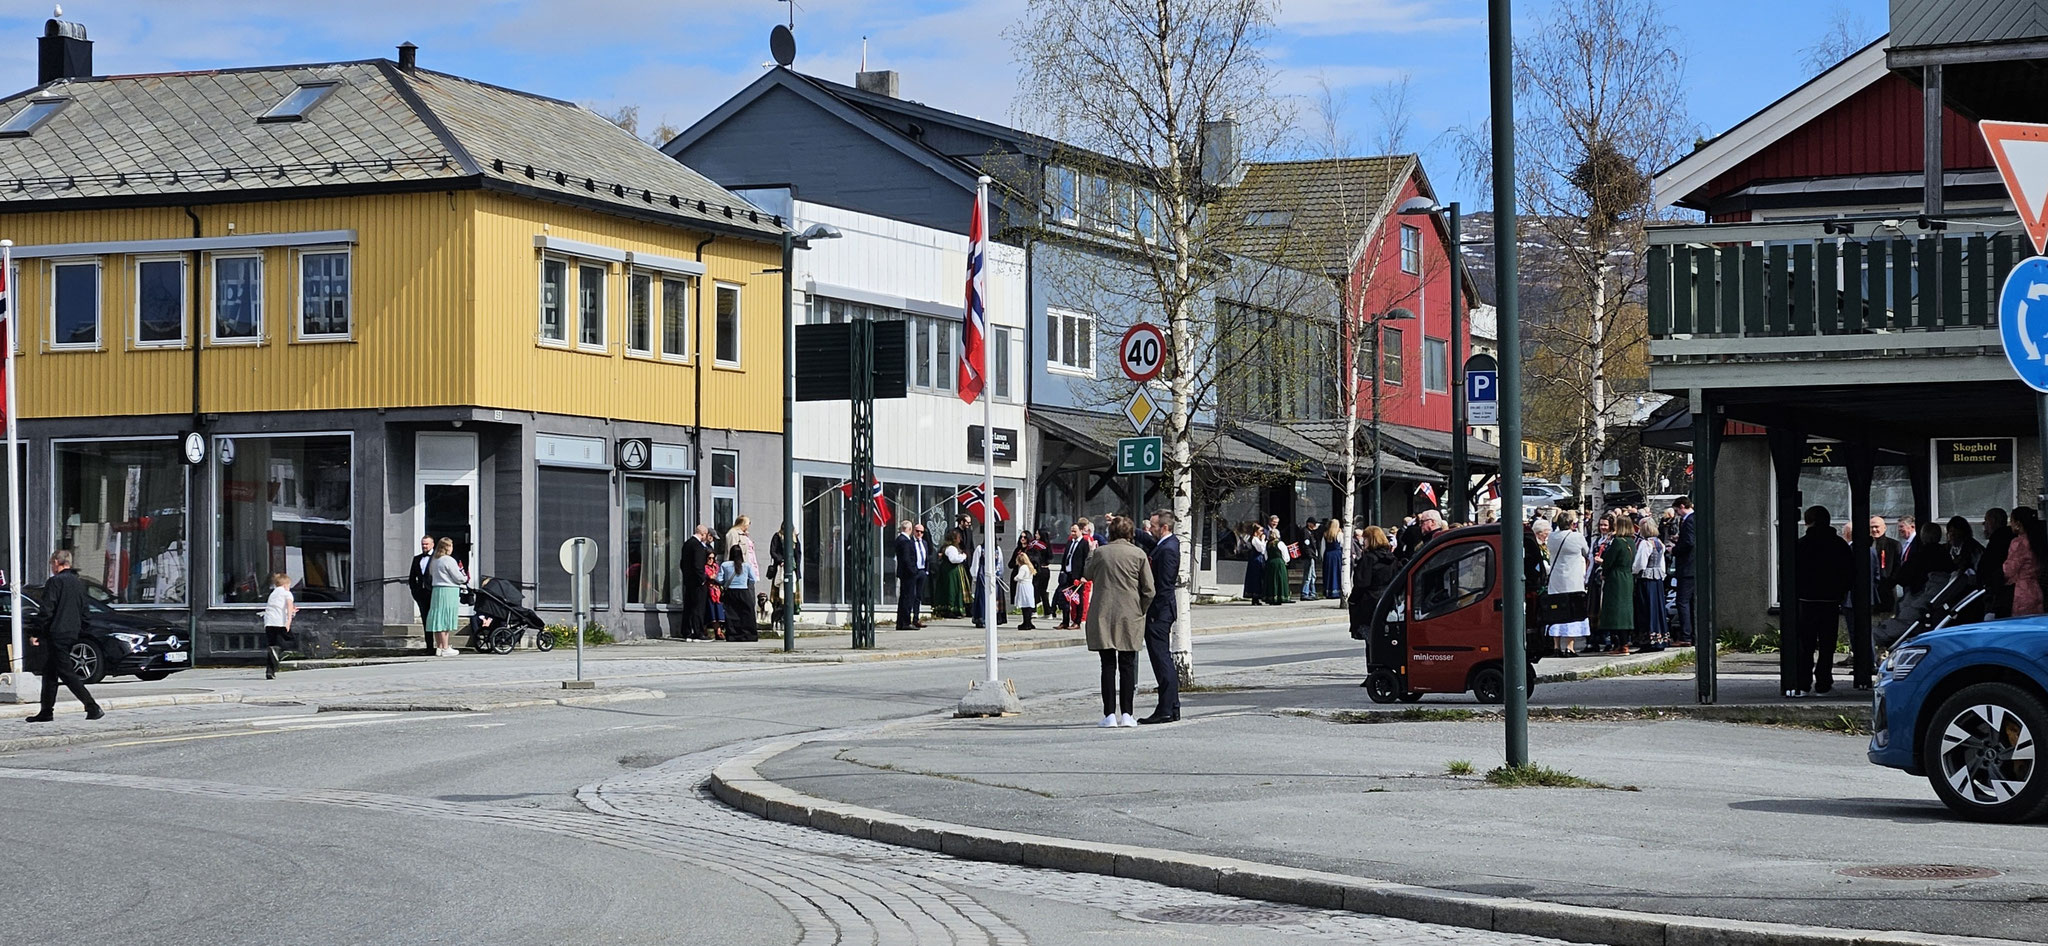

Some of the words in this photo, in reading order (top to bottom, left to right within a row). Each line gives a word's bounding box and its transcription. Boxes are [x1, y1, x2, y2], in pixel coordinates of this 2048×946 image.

[1127, 338, 1158, 367] 40
[1474, 375, 1490, 398] P
[188, 435, 202, 457] A
[625, 441, 644, 463] A
[1123, 444, 1135, 467] E
[1143, 443, 1155, 466] 6
[1953, 442, 1997, 452] Skogholt
[1953, 453, 1997, 462] Blomster
[1413, 653, 1454, 661] minicrosser
